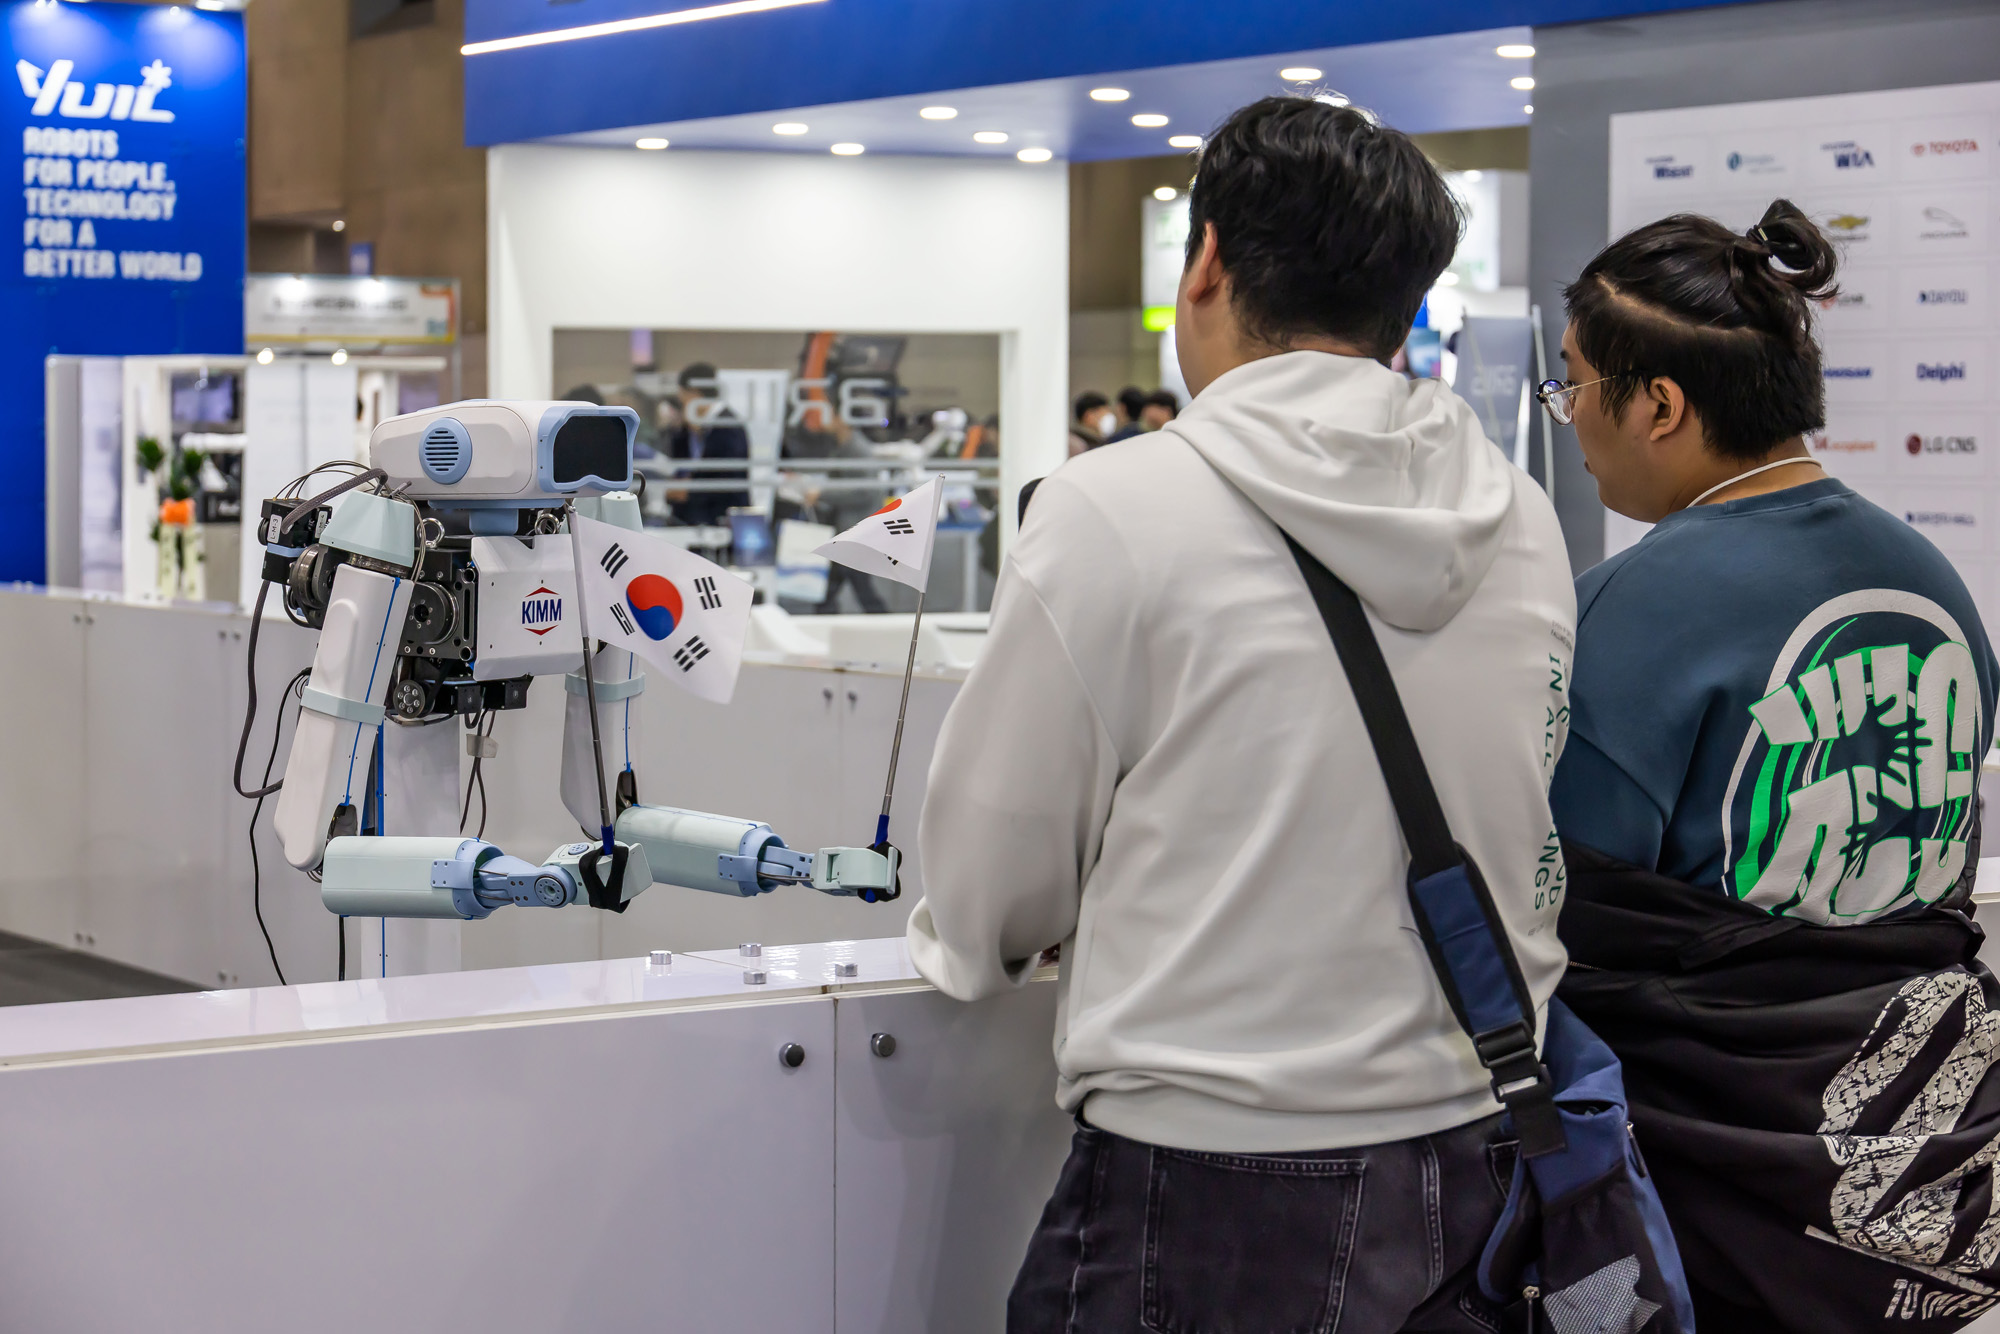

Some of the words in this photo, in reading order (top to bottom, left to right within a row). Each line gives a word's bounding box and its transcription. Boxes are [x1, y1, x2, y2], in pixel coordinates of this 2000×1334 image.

[23, 126, 119, 159] ROBOTS
[1929, 139, 1979, 155] TOYOTA
[23, 157, 73, 188] FOR
[77, 159, 176, 191] PEOPLE,
[23, 187, 177, 221] TECHNOLOGY
[23, 217, 73, 247] FOR
[76, 217, 97, 248] A
[23, 248, 116, 279] BETTER
[119, 250, 203, 282] WORLD
[1916, 362, 1966, 381] Delphi
[1923, 436, 1944, 453] LG
[1946, 436, 1977, 454] CNS
[522, 599, 562, 624] KIMM
[1549, 652, 1562, 692] IN
[1544, 706, 1555, 767] ALL
